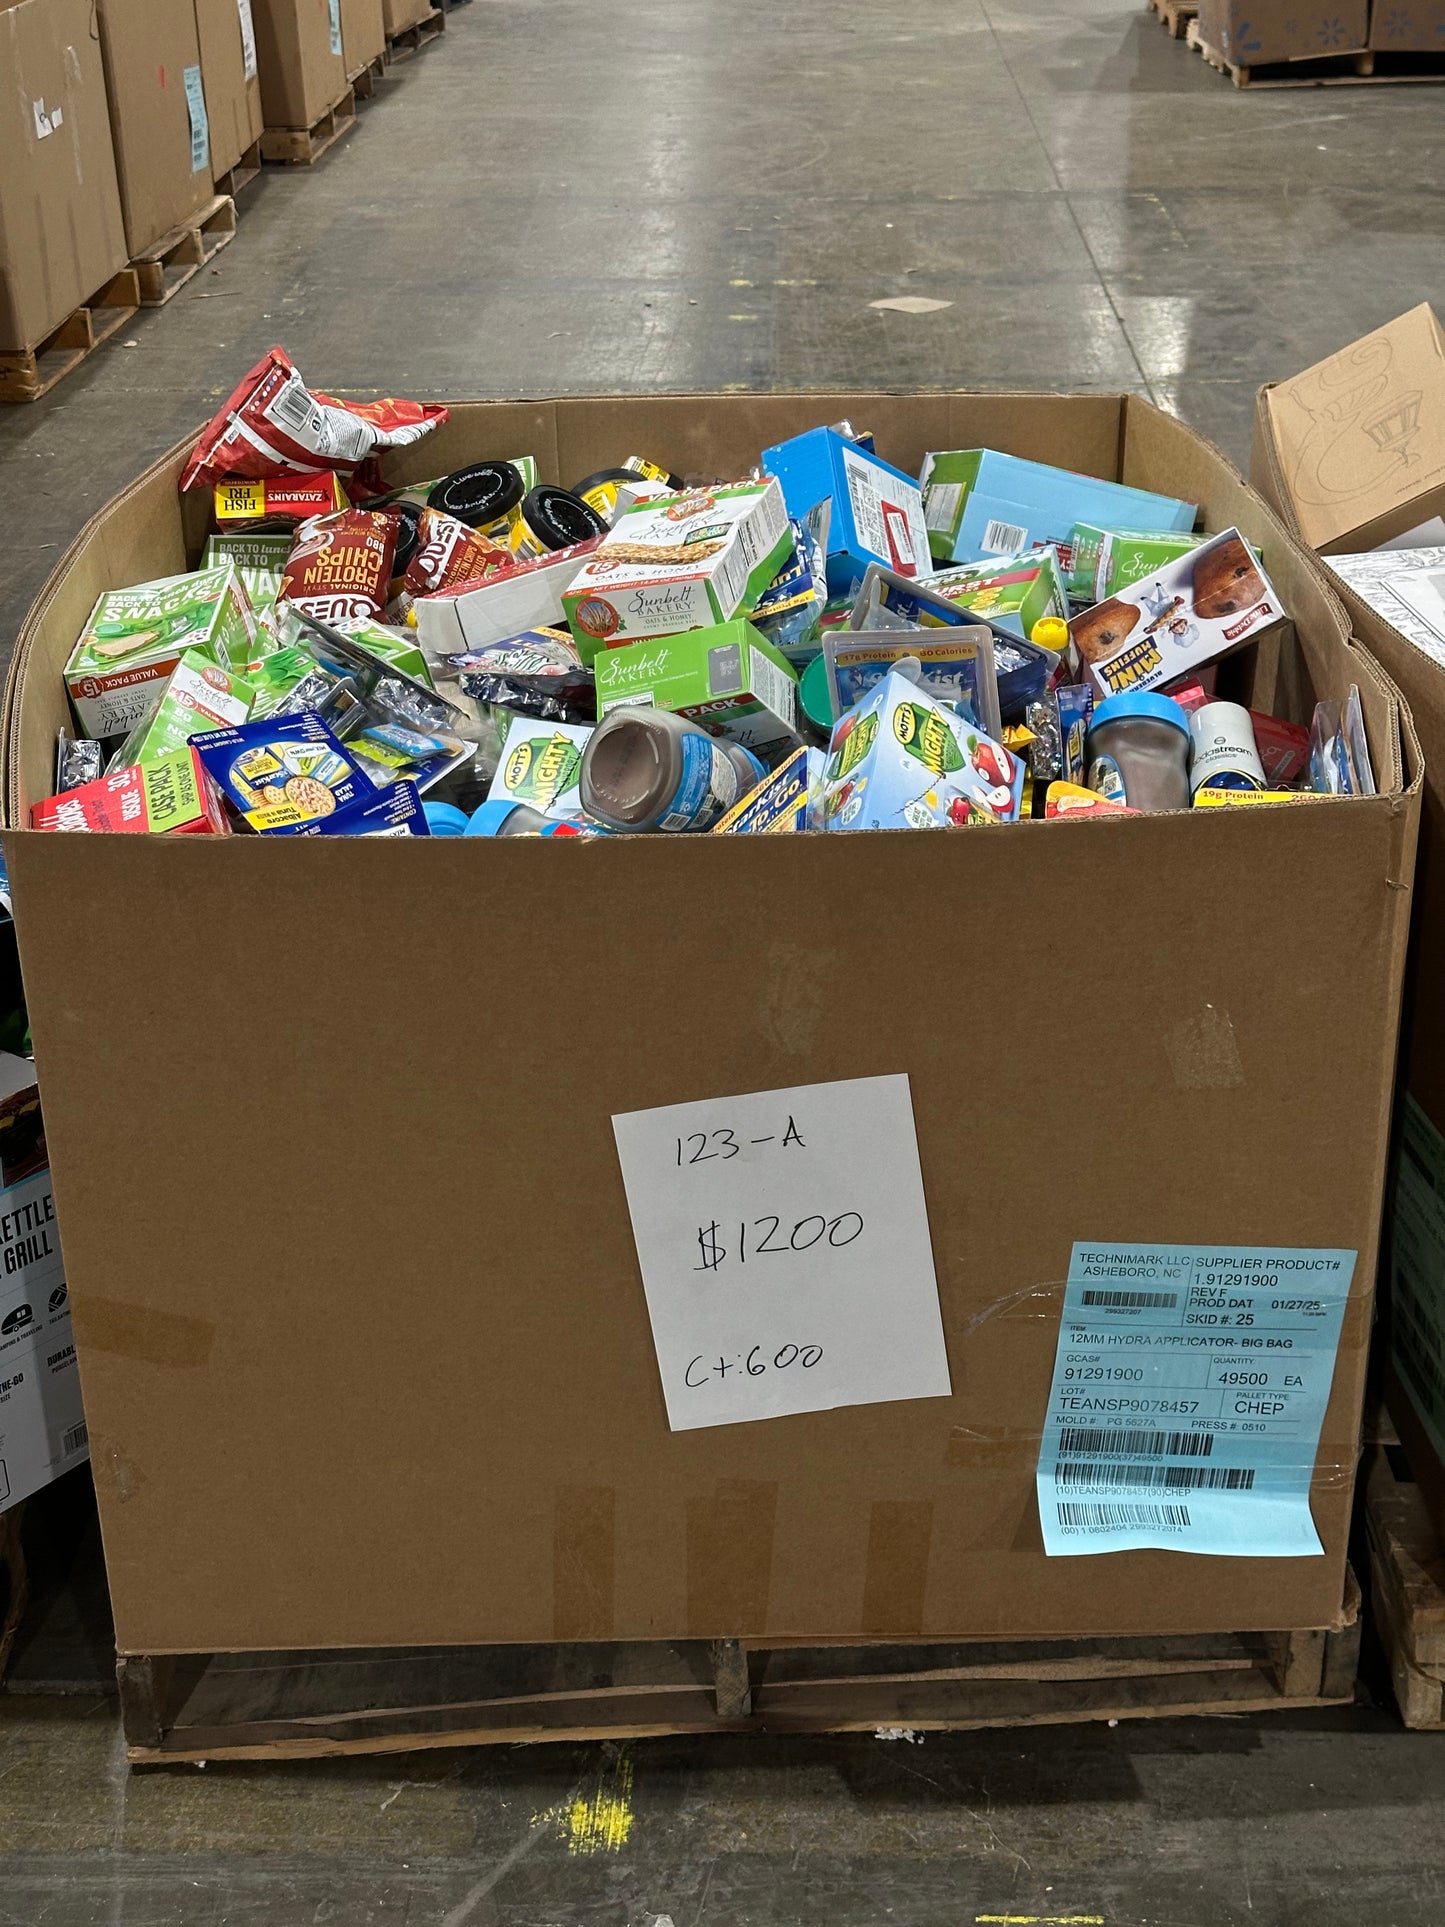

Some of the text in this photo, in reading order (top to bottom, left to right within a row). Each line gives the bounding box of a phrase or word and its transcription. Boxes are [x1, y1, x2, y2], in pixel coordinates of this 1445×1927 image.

[228, 487, 251, 499] FRI
[267, 492, 322, 502] ZATARAIN'S
[648, 479, 759, 502] VALUE PACK
[224, 498, 257, 511] FISH
[219, 543, 246, 554] BACK
[246, 543, 260, 554] TO
[365, 536, 385, 553] BBQ
[218, 552, 268, 566] BACK TO
[316, 545, 382, 573] CHIPS
[591, 561, 615, 573] 15
[303, 566, 379, 589] PROTEIN
[330, 583, 376, 595] ORIGINAL
[105, 600, 162, 608] BACK TO
[628, 585, 696, 613] Sunbelt
[287, 597, 378, 622] QUES
[638, 602, 692, 616] BAKERY
[644, 617, 661, 625] OATS
[669, 613, 692, 622] HONEY
[863, 651, 897, 661] Protein
[935, 646, 973, 657] Calories
[1103, 639, 1152, 678] MUFFINS
[600, 649, 673, 684] Sunbelt
[1110, 648, 1163, 692] MINI
[105, 668, 159, 688] VALUE PACK
[608, 667, 667, 687] BAKERY
[83, 682, 101, 697] 15
[99, 699, 122, 710] HONEY
[683, 697, 742, 719] PACK
[899, 707, 913, 741] MOTT'S
[921, 705, 950, 779] MIGHTY
[1205, 753, 1238, 764] classics
[529, 730, 572, 808] MIGHTY
[147, 762, 174, 795] PACK
[337, 792, 355, 803] TUNA
[1203, 790, 1223, 800] 19g
[1225, 791, 1264, 800] Protein
[120, 788, 142, 822] BISQUE
[150, 789, 178, 821] CASE
[275, 806, 297, 816] Tuna
[266, 812, 303, 825] Albacore
[0, 1193, 55, 1245] ETTLE
[693, 1211, 864, 1272] $1200
[4, 1230, 54, 1275] GRILL
[1079, 1252, 1191, 1266] TECHNIMARK LLC
[1195, 1257, 1341, 1271] SUPPLIER PRODUCT#
[1083, 1266, 1182, 1279] ASHEBORO, NC
[1194, 1272, 1279, 1287] 1.91291900
[1190, 1287, 1228, 1298] REV F
[1188, 1297, 1321, 1311] PROD DAT 01/27/25
[1185, 1313, 1255, 1326] SKID #: 25
[0, 1339, 17, 1352] AMPING
[1070, 1333, 1294, 1350] 12MM HYDRA APPLICATOR- BIG BAG
[46, 1343, 77, 1368] DURABL
[1066, 1354, 1101, 1364] GCAS#
[1064, 1367, 1144, 1382] 91291900
[1218, 1371, 1304, 1387] 49500 EA
[1060, 1387, 1087, 1396] LOT#
[1235, 1391, 1267, 1400] PALLET
[1059, 1396, 1200, 1414] TEANSP9078457
[1234, 1400, 1285, 1416] CHEP
[1056, 1415, 1088, 1425] MOLD
[1107, 1417, 1123, 1427] PG
[1191, 1420, 1228, 1431] PRESS
[1241, 1423, 1267, 1432] 0510
[1058, 1451, 1164, 1463] (91)91291900(37)49500
[1056, 1485, 1192, 1498] (10)TEANSP9078457(90)CHEP
[1061, 1525, 1079, 1537] (00)
